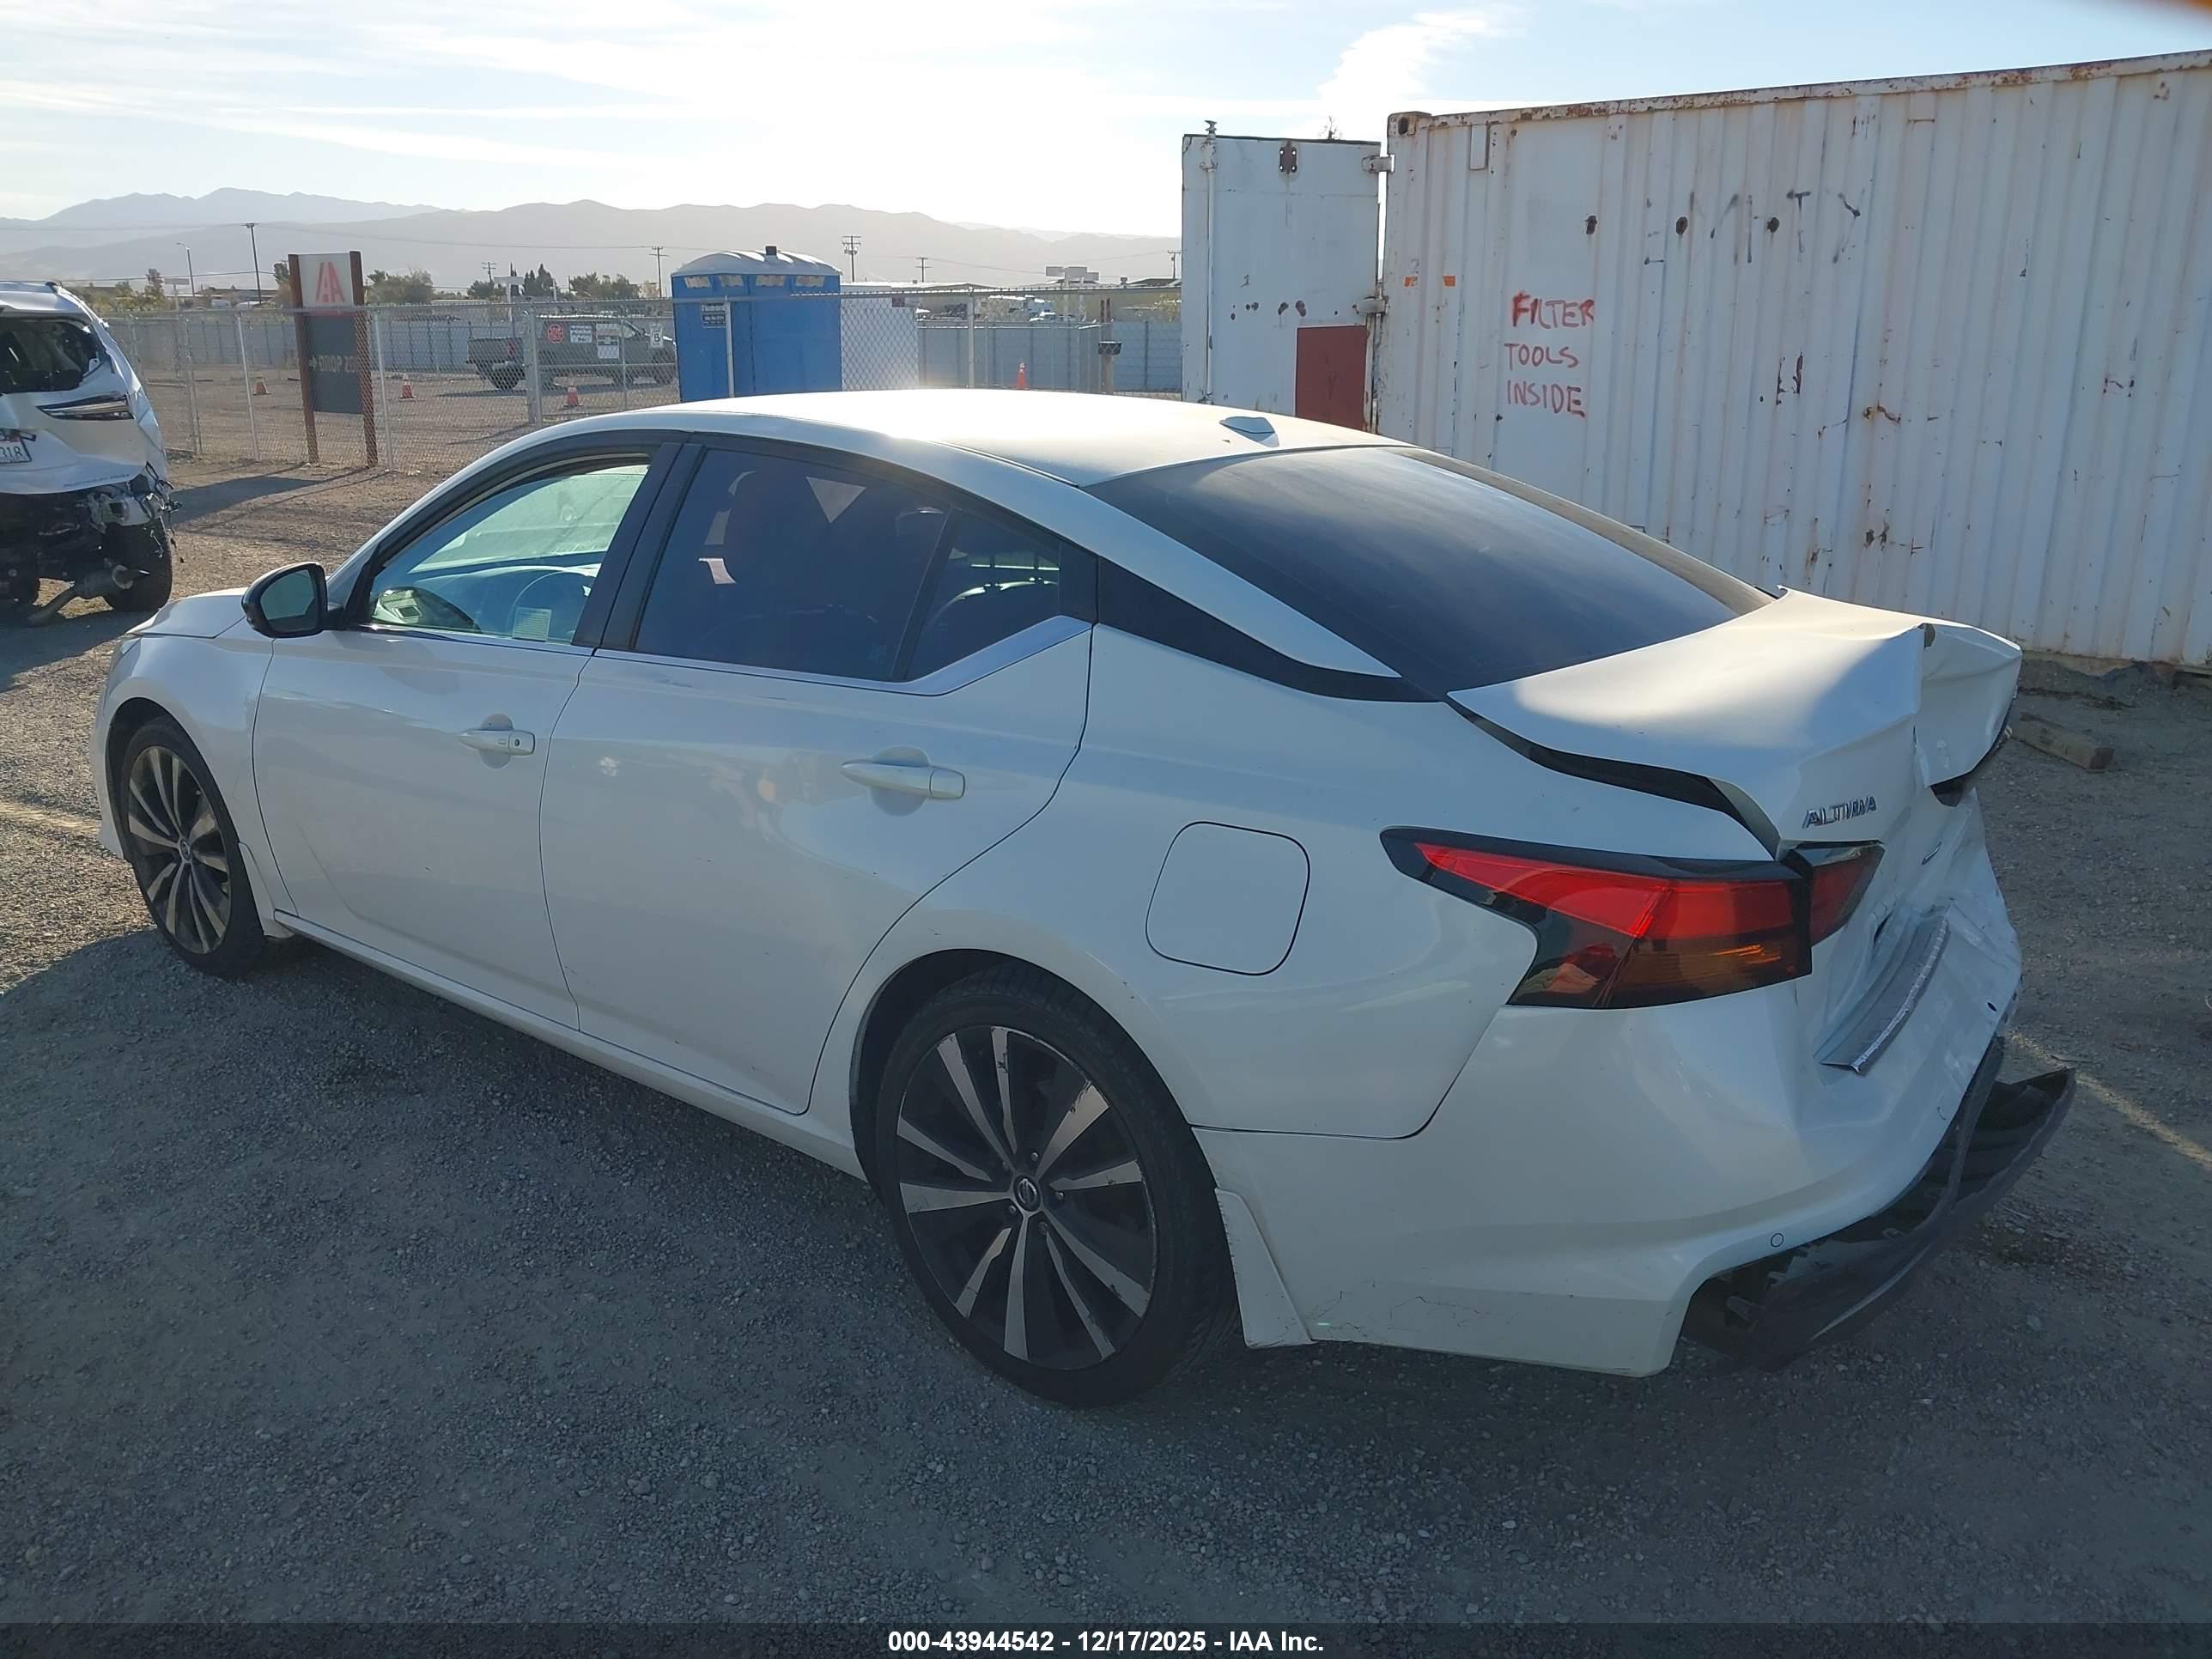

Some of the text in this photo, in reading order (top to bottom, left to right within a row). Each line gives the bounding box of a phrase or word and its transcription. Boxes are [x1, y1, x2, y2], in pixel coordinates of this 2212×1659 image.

[1511, 289, 1595, 329] FILTER
[1504, 342, 1580, 371] TOOLS
[1507, 380, 1586, 417] INSIDE
[1802, 794, 1878, 829] ALTIMA
